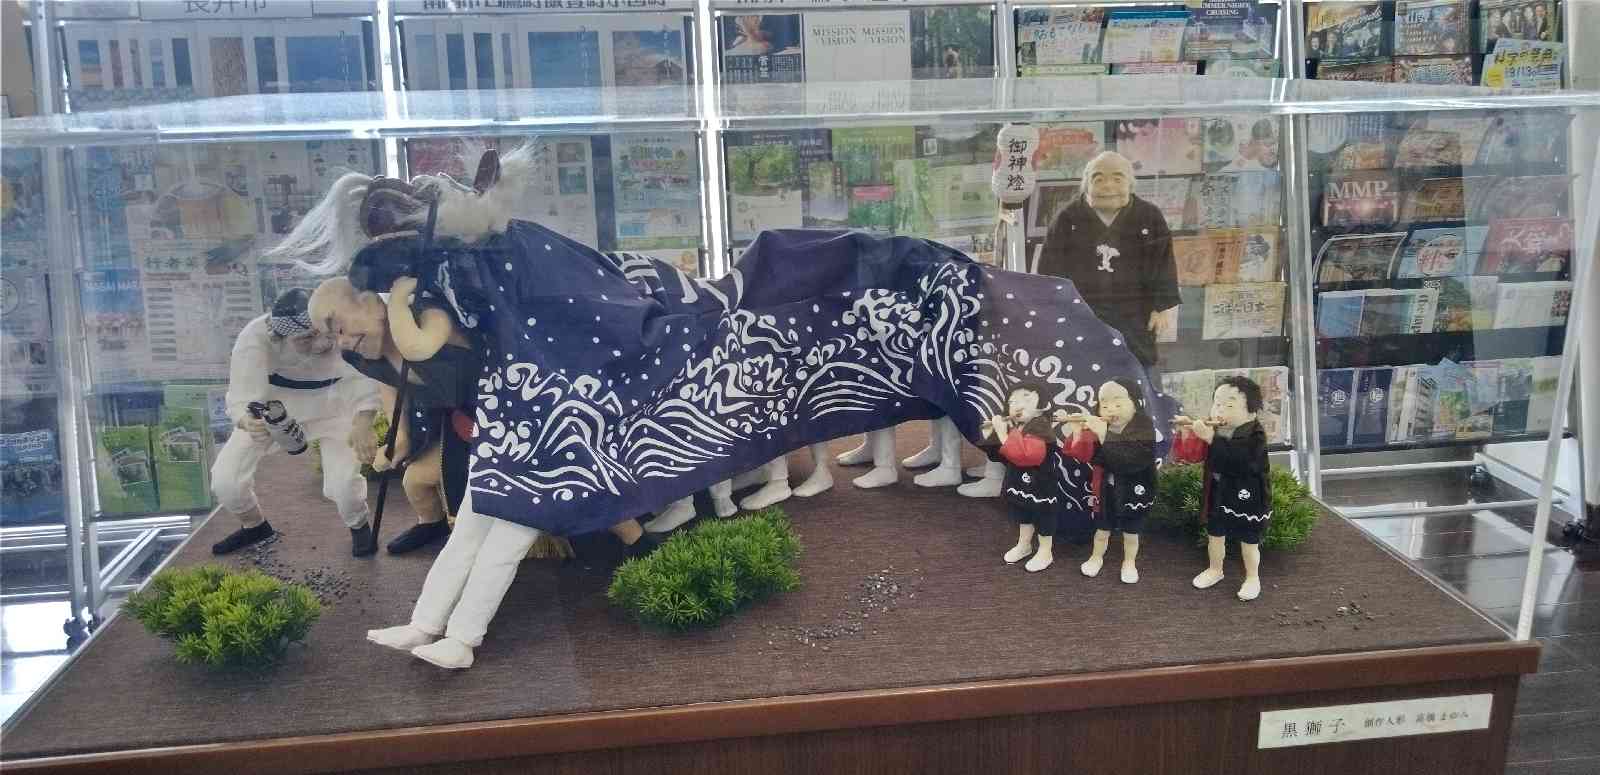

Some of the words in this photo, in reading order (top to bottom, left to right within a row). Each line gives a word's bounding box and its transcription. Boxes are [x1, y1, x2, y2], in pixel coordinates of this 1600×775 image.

[1008, 138, 1028, 191] 御神燈
[1327, 180, 1389, 200] MMP
[1280, 717, 1346, 738] 黒獅子
